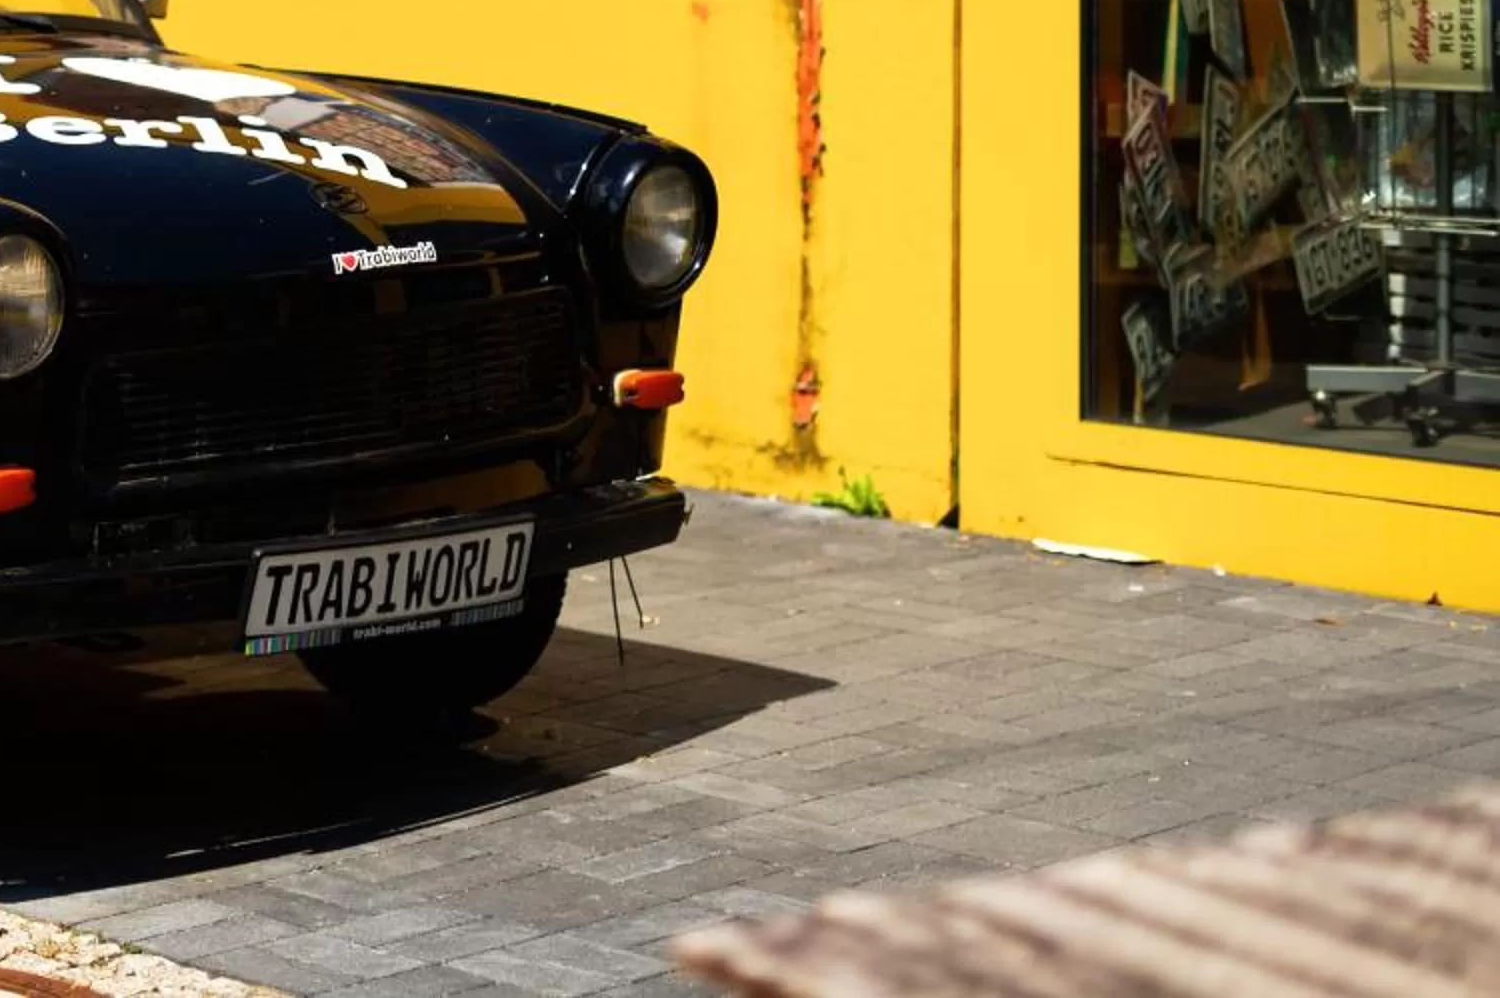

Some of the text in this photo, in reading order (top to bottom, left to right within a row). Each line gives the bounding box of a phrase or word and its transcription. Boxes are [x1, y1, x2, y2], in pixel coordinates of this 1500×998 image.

[1438, 11, 1454, 53] RICE
[358, 242, 436, 270] Trabiworld
[265, 531, 526, 626] TRABIWORLD
